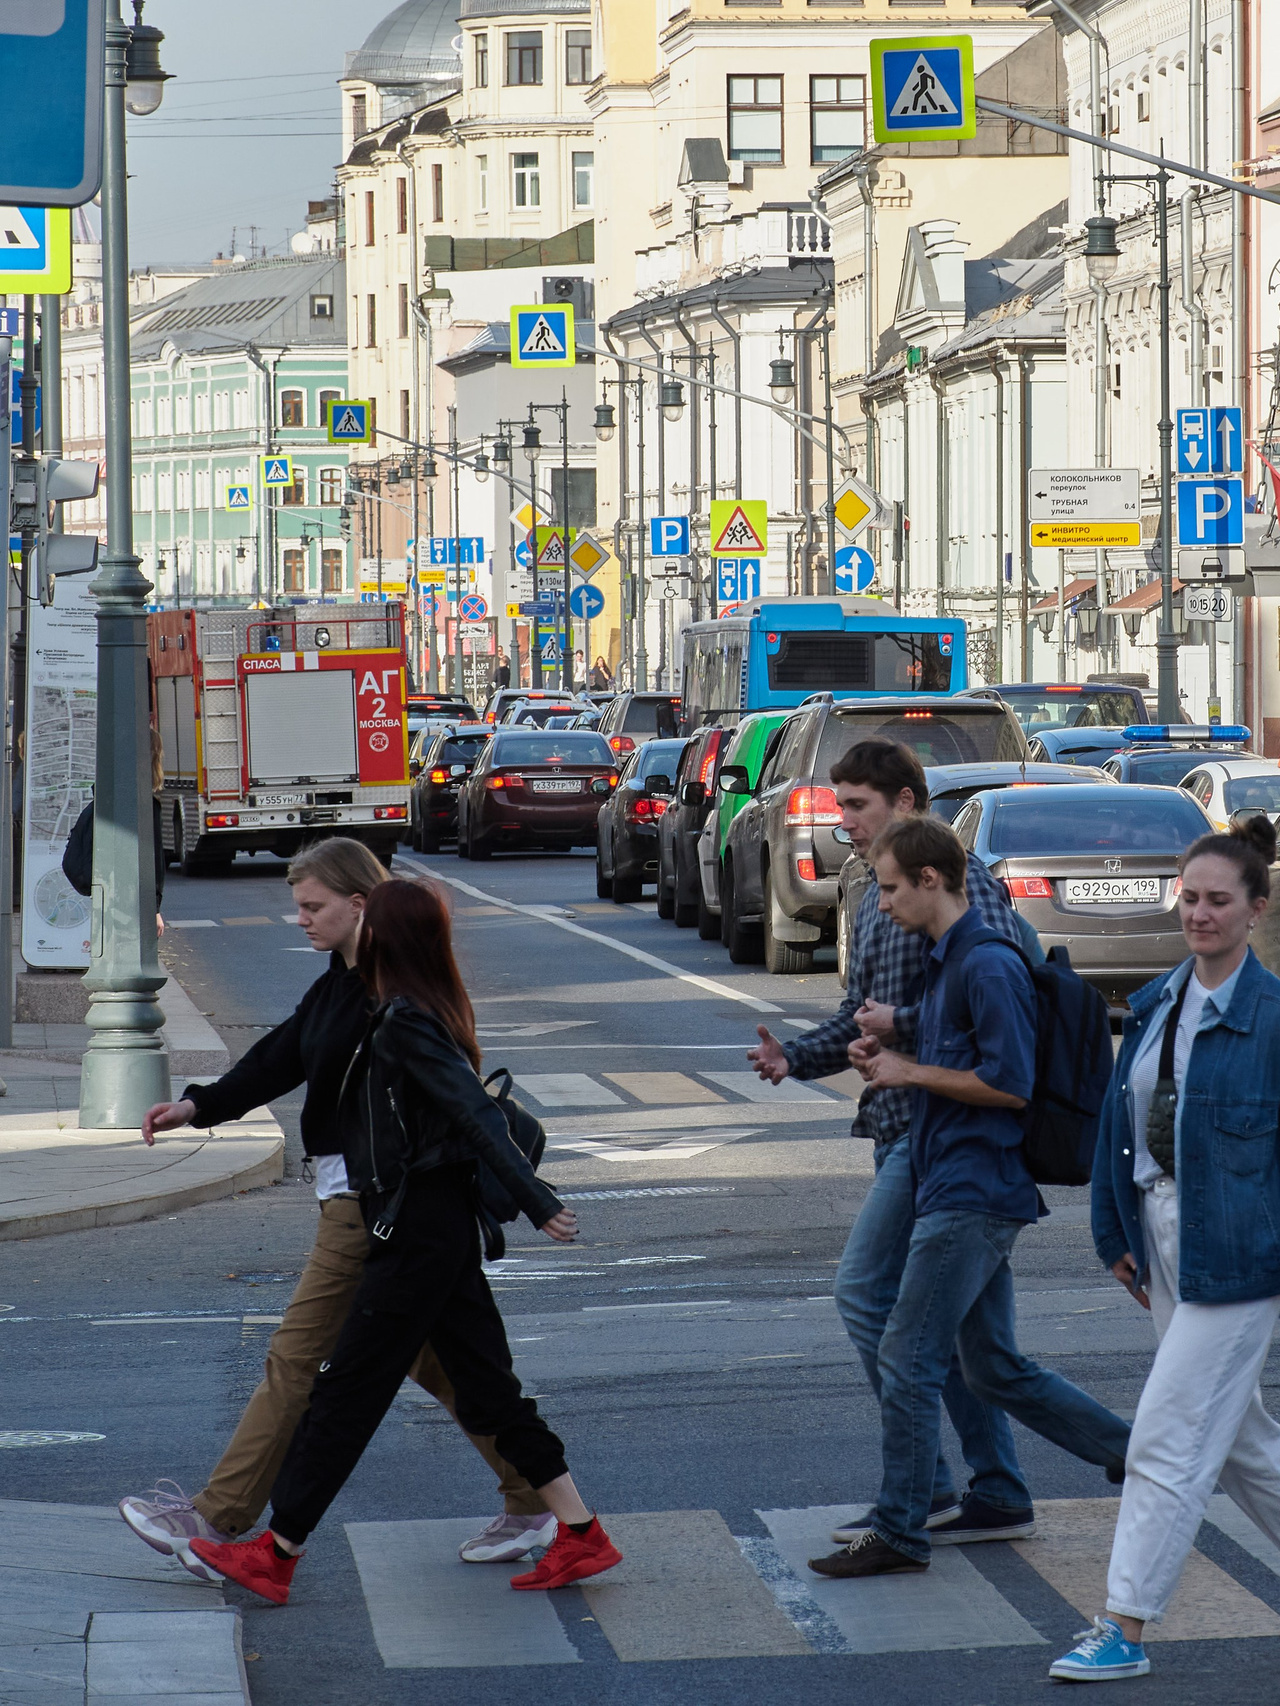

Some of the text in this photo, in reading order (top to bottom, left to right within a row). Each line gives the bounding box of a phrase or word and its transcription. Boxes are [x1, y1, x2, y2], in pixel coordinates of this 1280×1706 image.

[1190, 598, 1225, 611] 10 15 20
[358, 670, 399, 695] АГ
[372, 698, 386, 718] 2
[360, 719, 400, 728] МОСКВА
[1072, 880, 1156, 896] С929ОК 199
